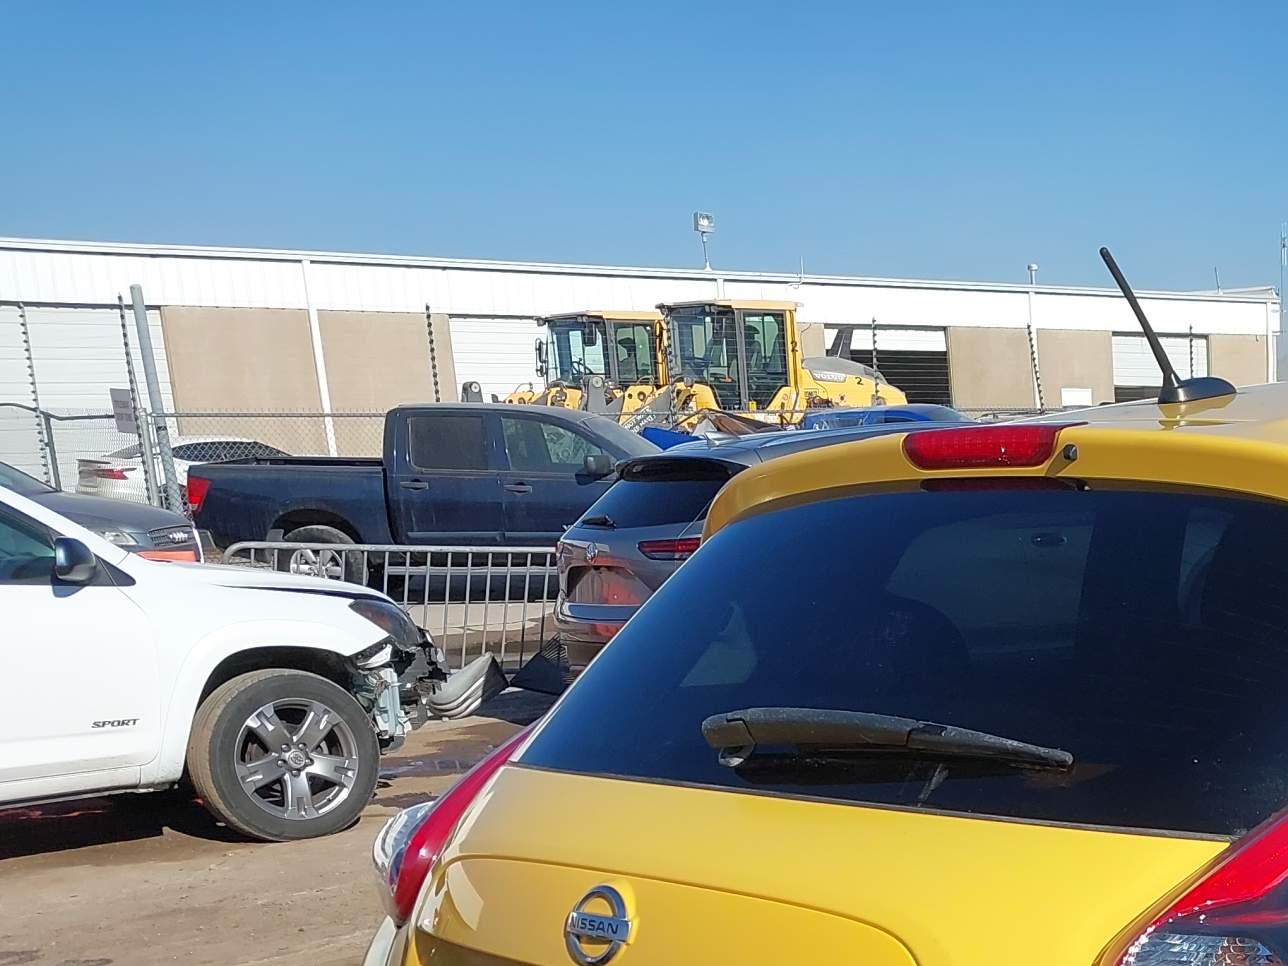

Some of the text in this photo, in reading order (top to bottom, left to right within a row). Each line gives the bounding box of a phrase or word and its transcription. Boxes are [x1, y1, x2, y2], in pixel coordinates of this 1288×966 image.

[854, 376, 865, 386] 2
[91, 718, 141, 729] SPORT
[569, 914, 619, 935] NISSAN
